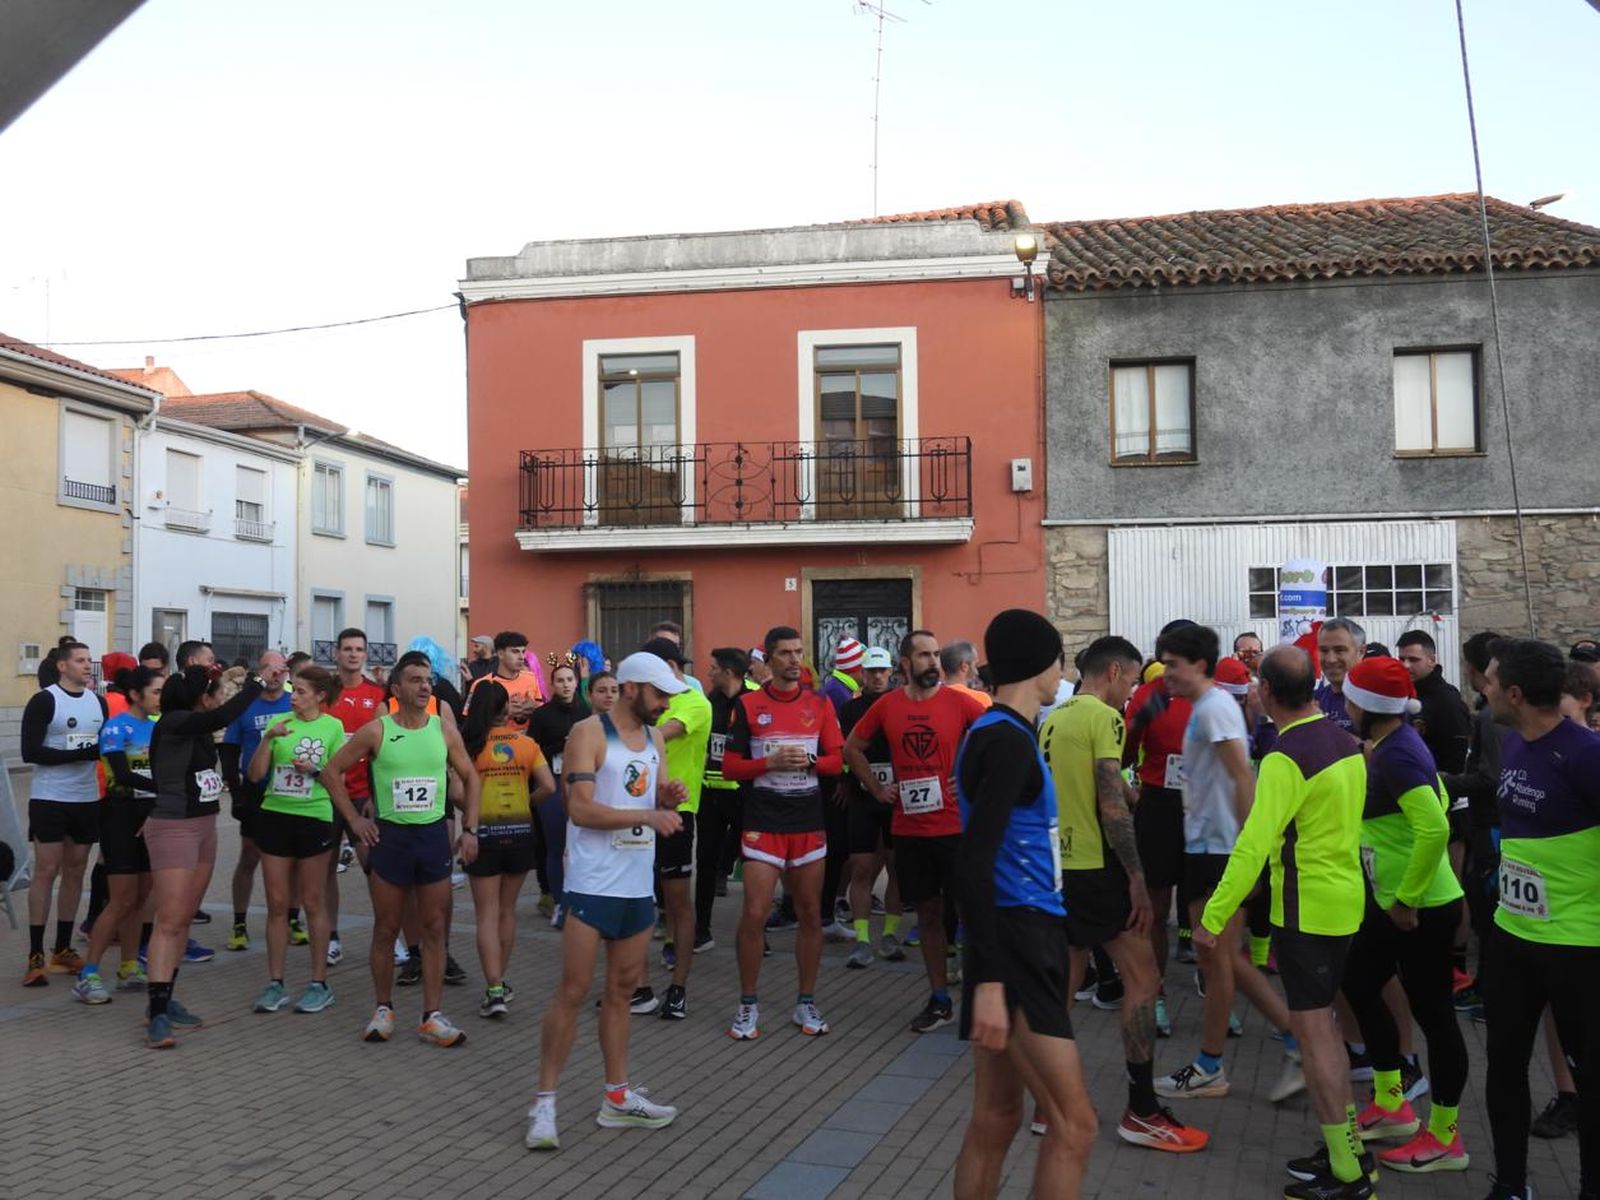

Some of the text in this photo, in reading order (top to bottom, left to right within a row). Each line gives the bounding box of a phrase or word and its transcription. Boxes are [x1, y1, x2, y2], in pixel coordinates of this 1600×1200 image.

[284, 773, 305, 788] 13
[404, 786, 428, 802] 12
[909, 787, 931, 804] 27
[1502, 873, 1539, 904] 110
